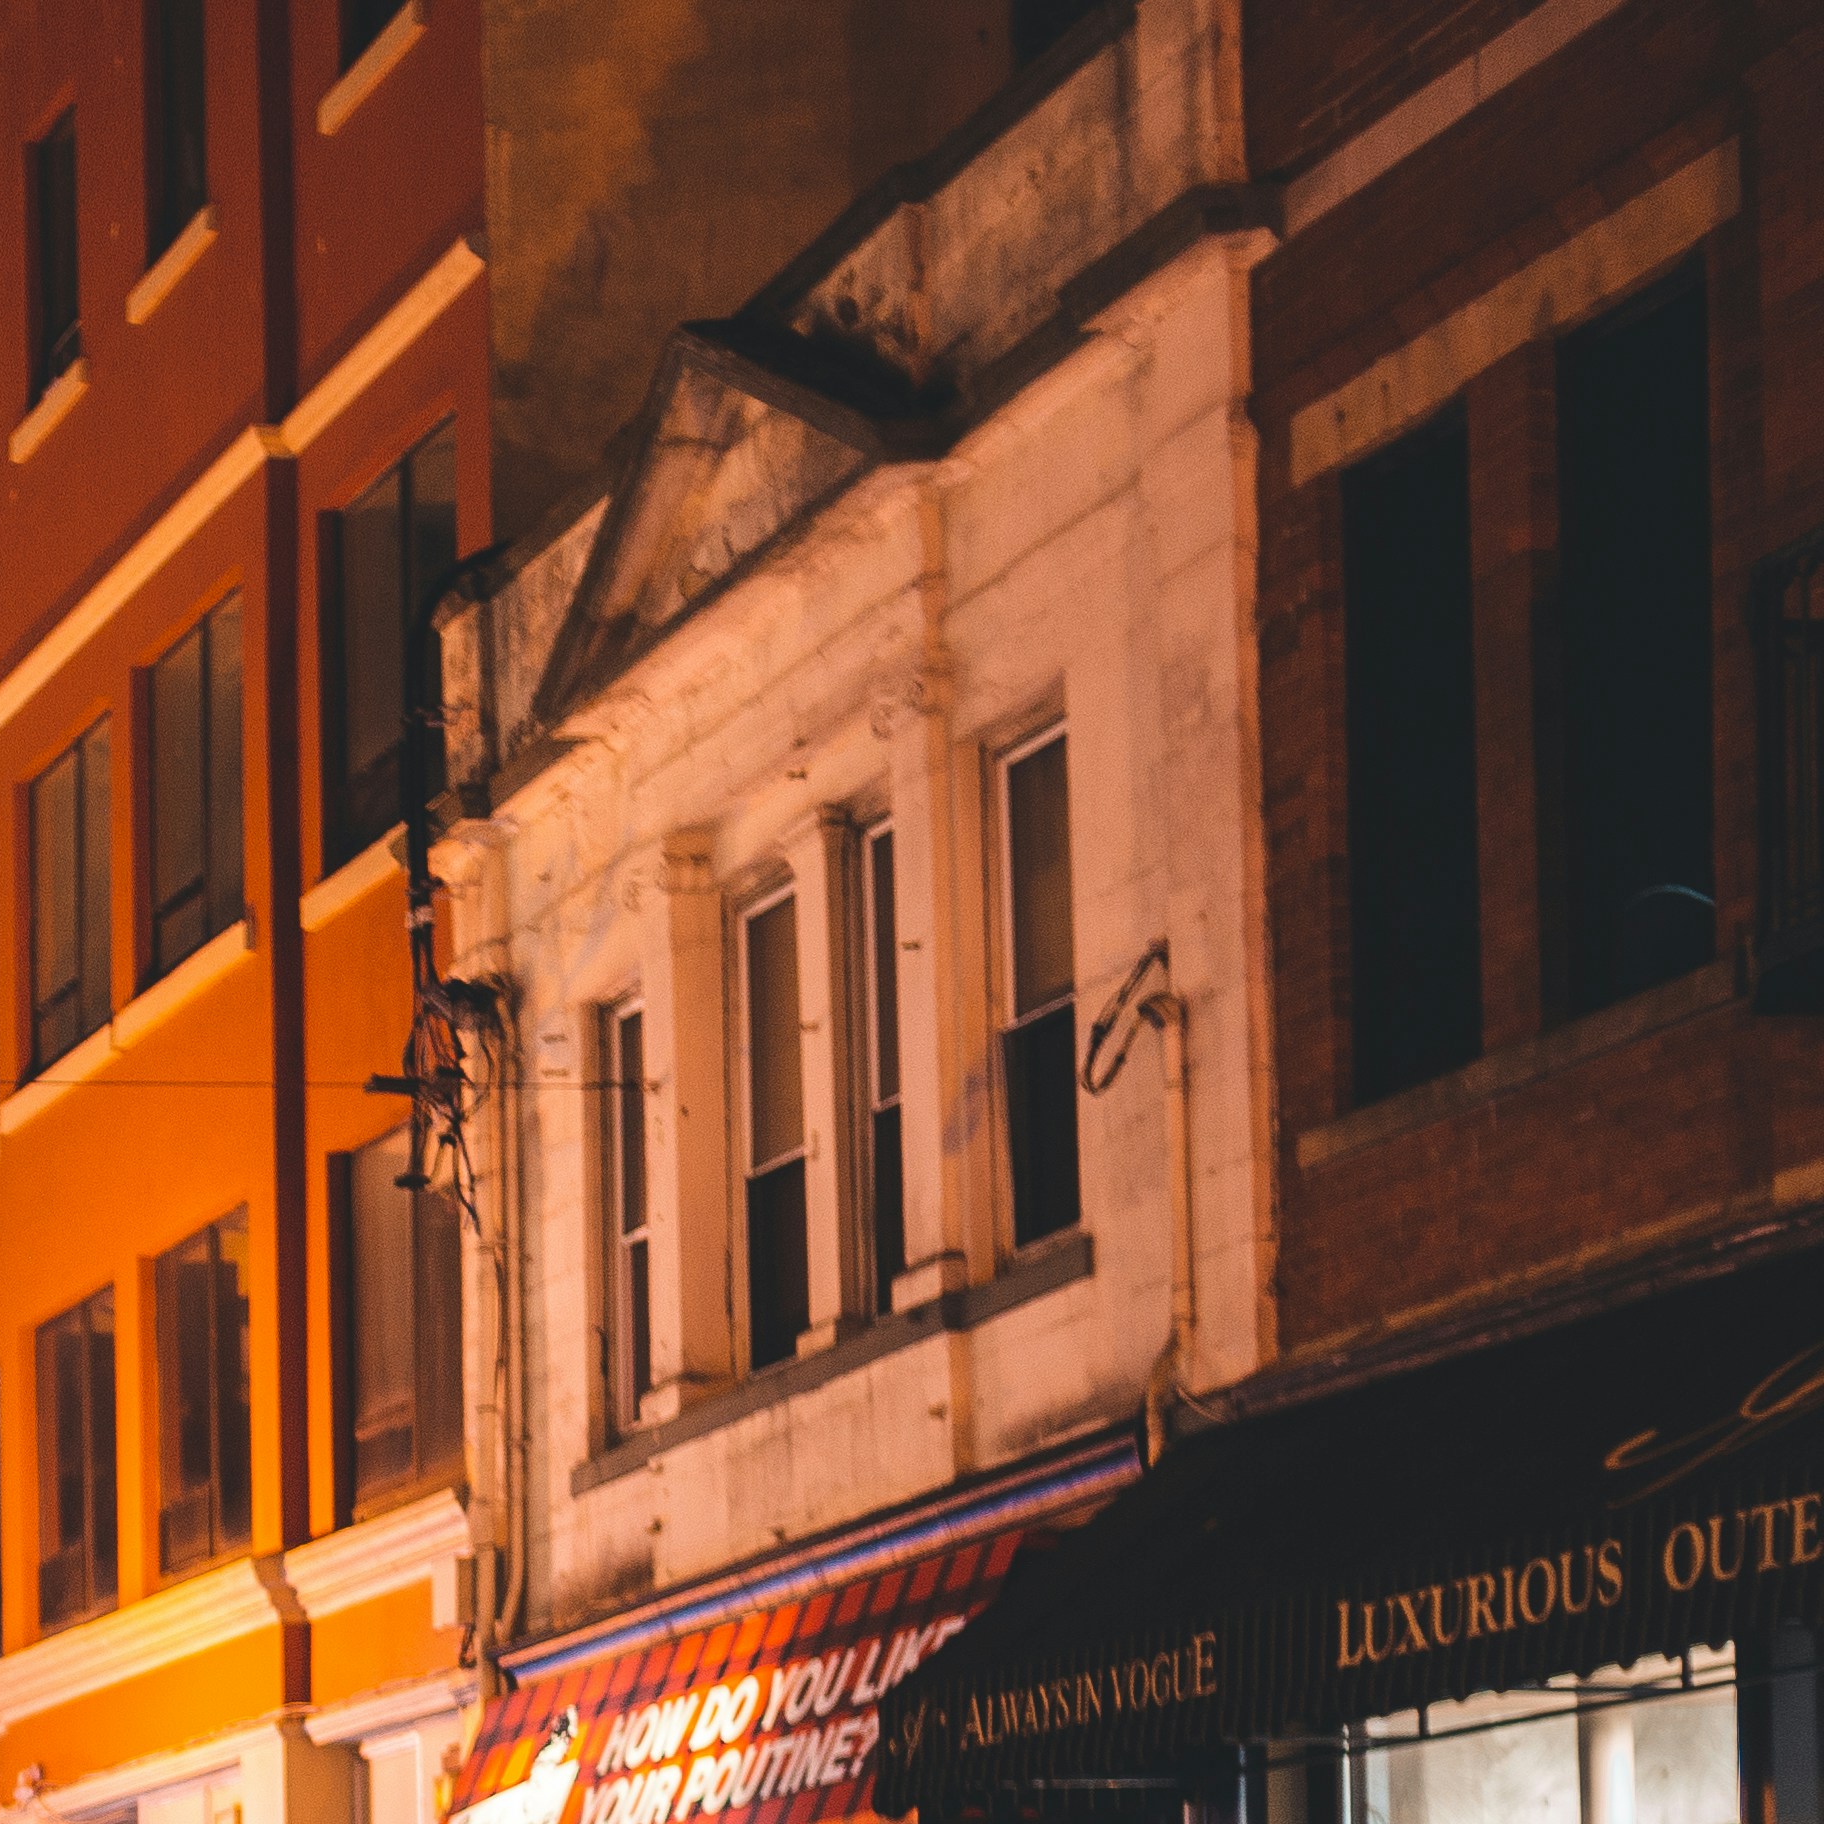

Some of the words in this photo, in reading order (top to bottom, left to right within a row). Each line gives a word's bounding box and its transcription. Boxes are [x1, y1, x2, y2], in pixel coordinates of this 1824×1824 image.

[1337, 1538, 1623, 1670] LUXURIOUS
[1663, 1494, 1824, 1592] OUTE
[597, 1693, 698, 1776] HOW
[688, 1675, 760, 1753] DO
[761, 1648, 856, 1732] YOU
[959, 1678, 1071, 1750] ALWAYS
[1076, 1669, 1102, 1726] IN
[1110, 1631, 1218, 1712] VOGUE
[674, 1708, 880, 1823] POUTINE?
